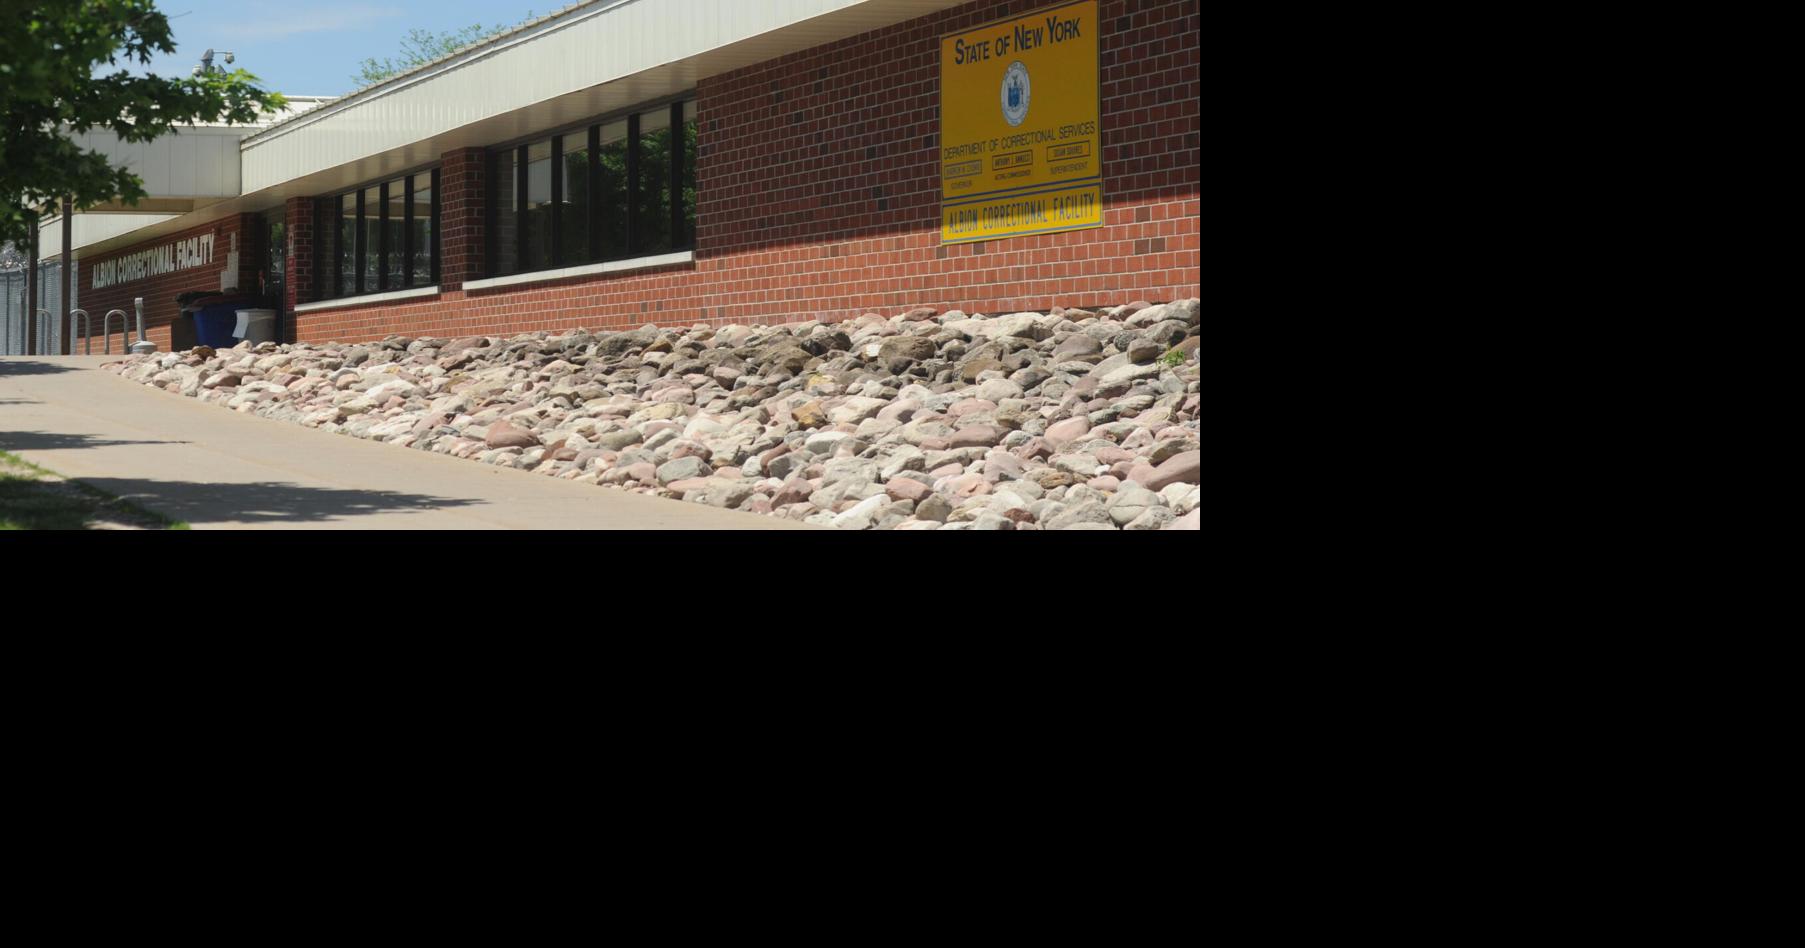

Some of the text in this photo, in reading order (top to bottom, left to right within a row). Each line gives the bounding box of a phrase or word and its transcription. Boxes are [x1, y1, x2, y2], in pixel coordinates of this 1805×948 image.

[955, 16, 1081, 65] STATE OF NEW YORK
[944, 121, 1095, 160] DEPARTMENT OF CORRECTIONAL SERVICES
[948, 191, 1095, 234] ALBION CORRECTIONAL FACILITY
[92, 232, 215, 289] ALBION CORRECTIONAL FACILITY
